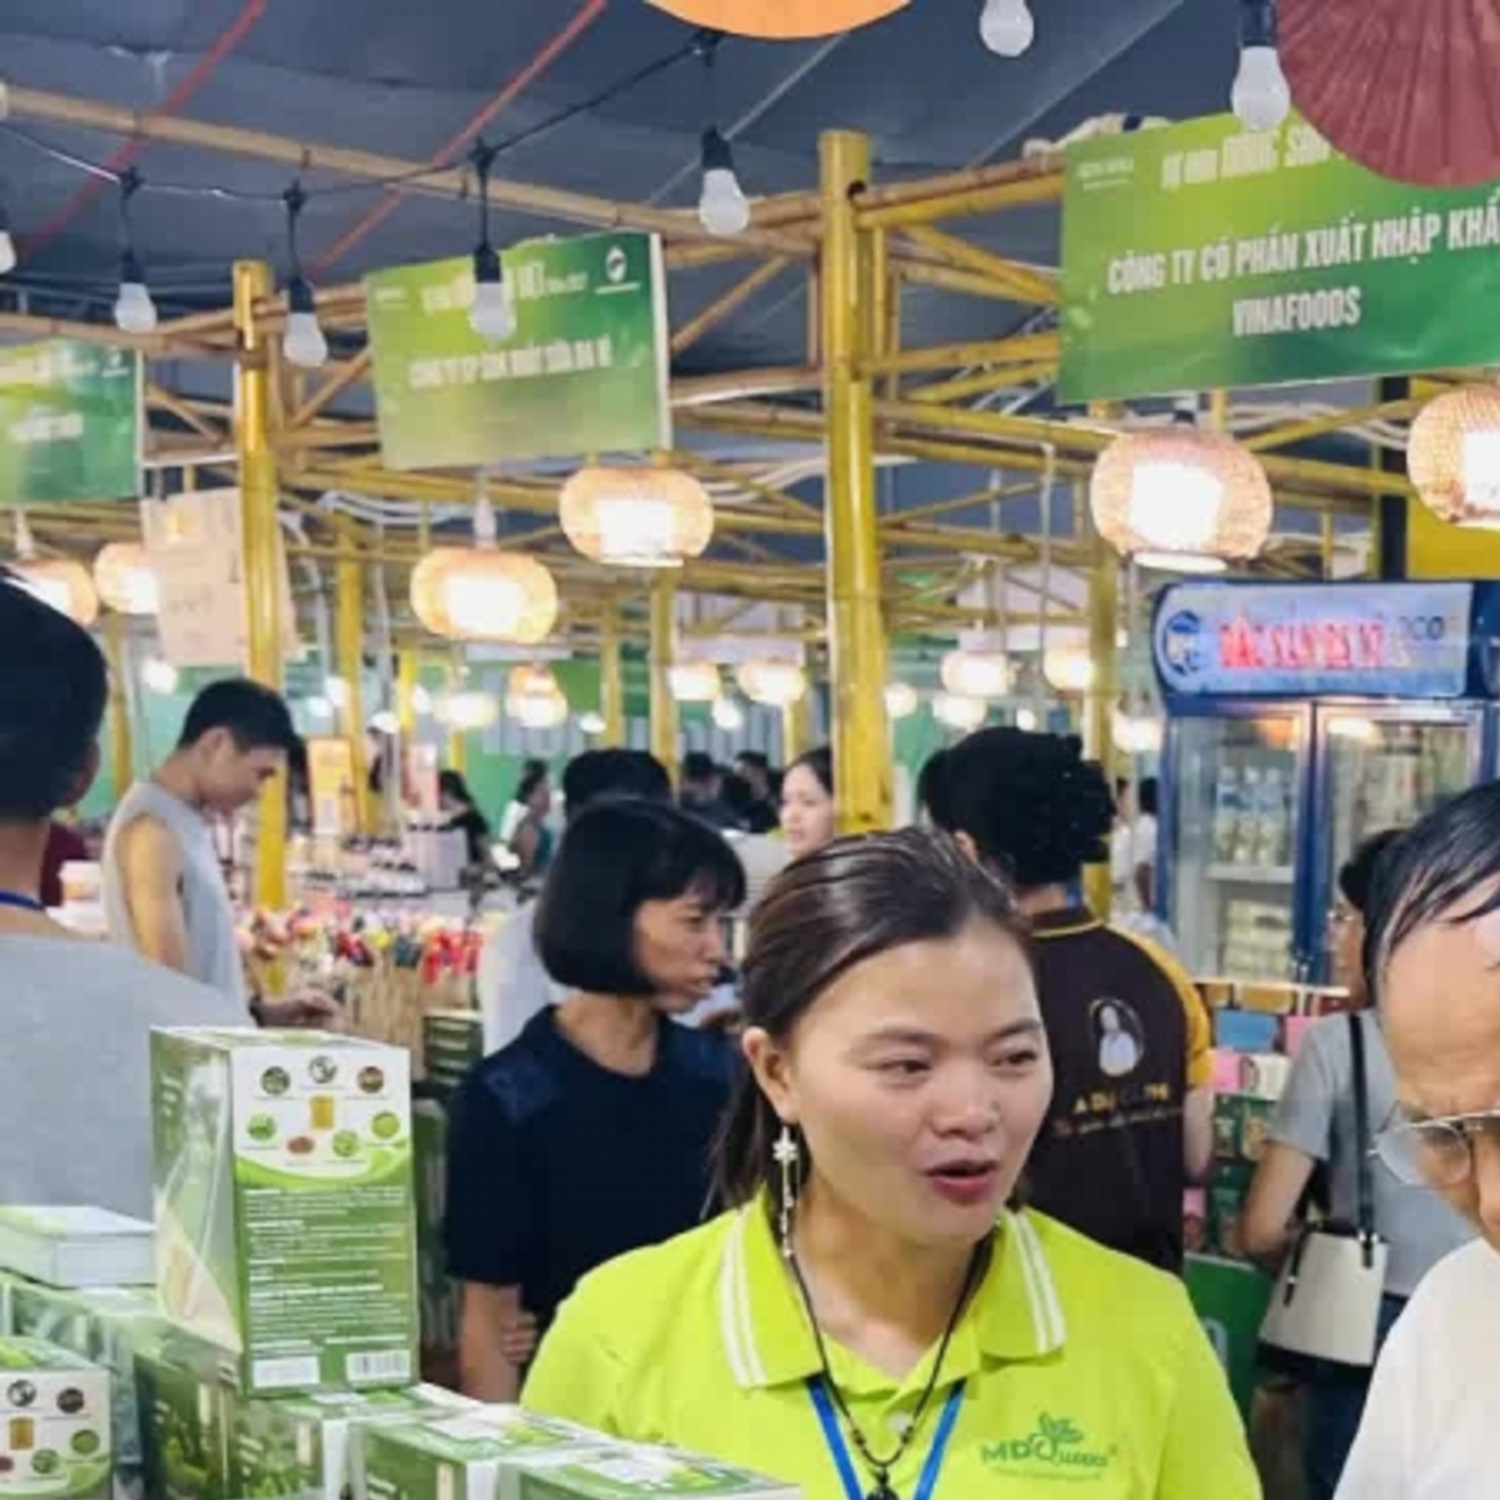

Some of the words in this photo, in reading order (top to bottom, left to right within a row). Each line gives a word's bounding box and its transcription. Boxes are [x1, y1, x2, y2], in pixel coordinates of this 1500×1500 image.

[1107, 249, 1166, 294] CÔNG
[1171, 249, 1197, 285] TY
[1303, 211, 1367, 267] XUẤT
[1372, 207, 1441, 264] NHẬP
[1232, 285, 1362, 338] VINAFOODS
